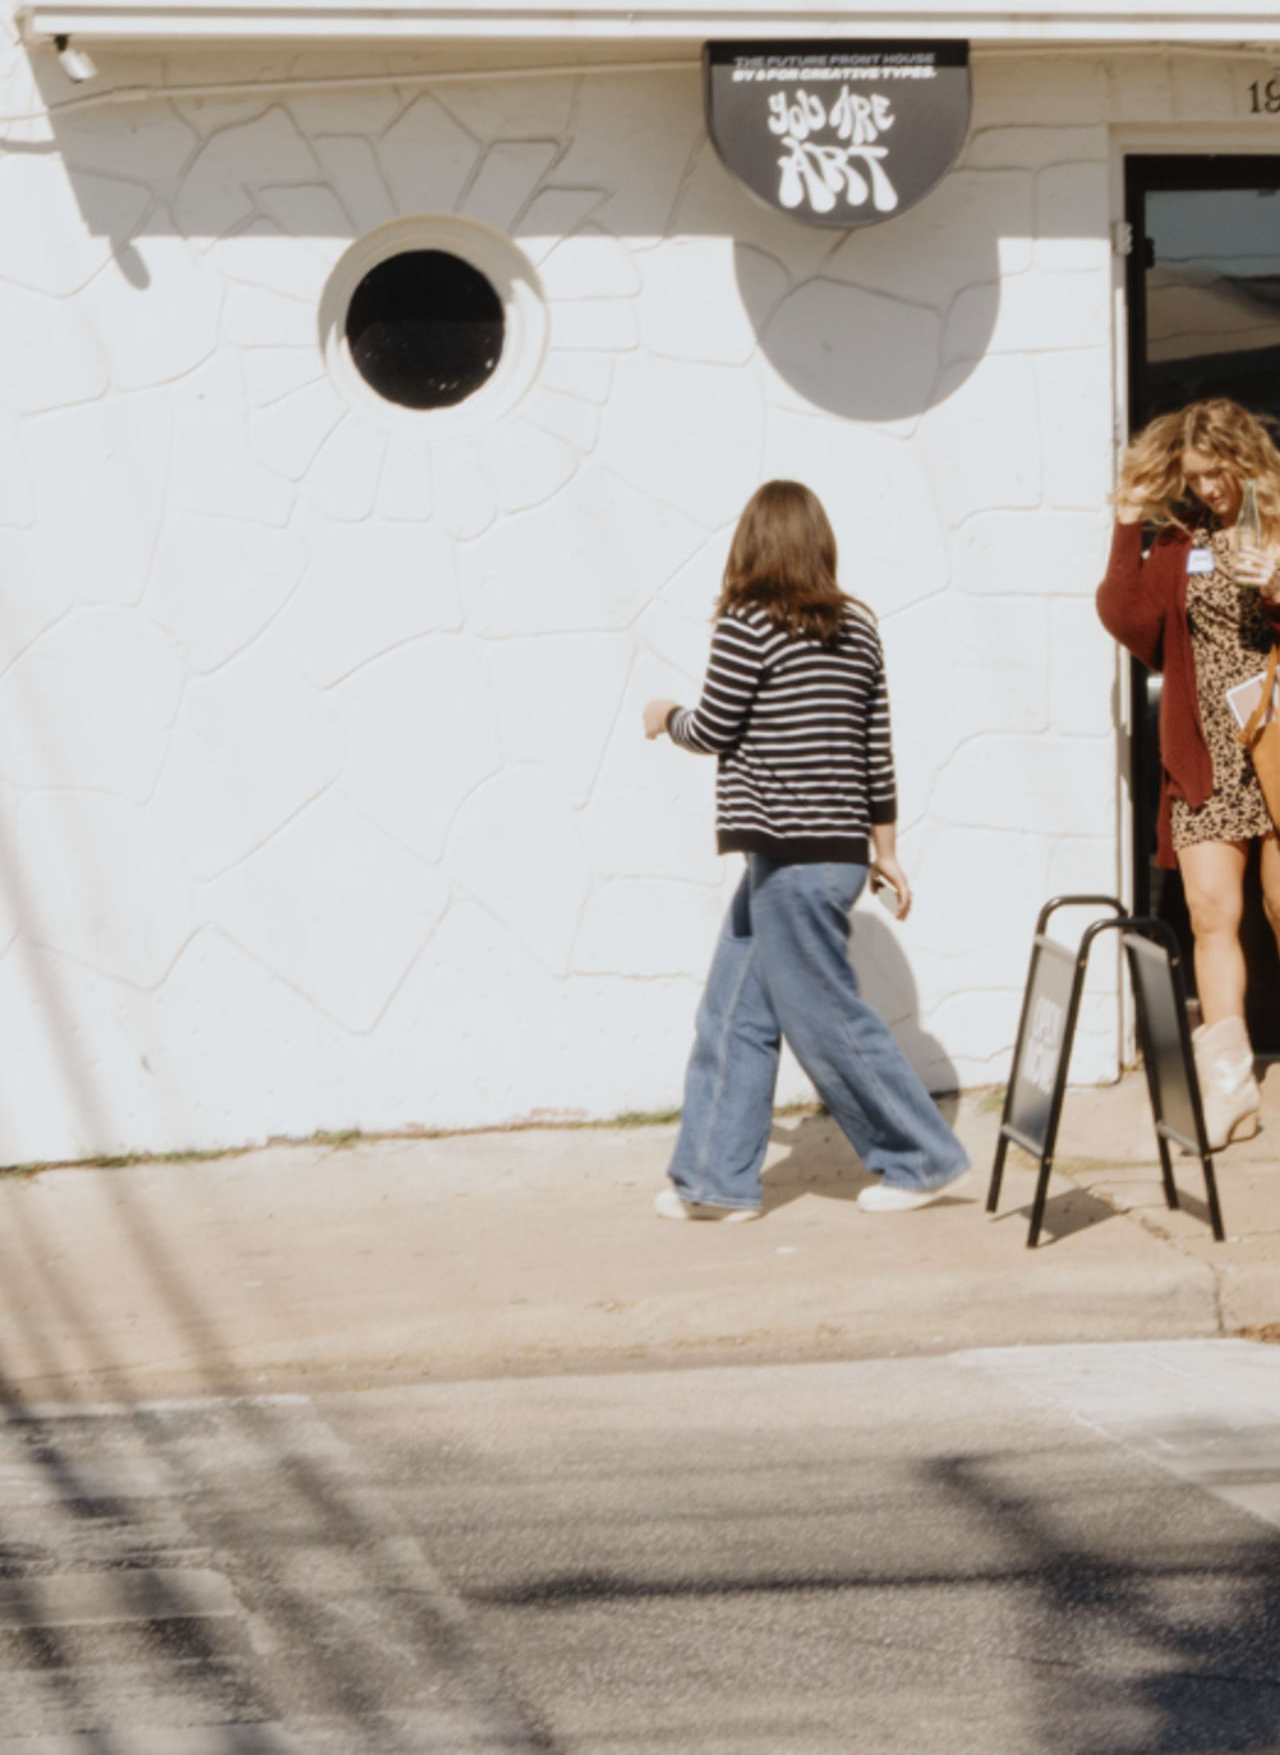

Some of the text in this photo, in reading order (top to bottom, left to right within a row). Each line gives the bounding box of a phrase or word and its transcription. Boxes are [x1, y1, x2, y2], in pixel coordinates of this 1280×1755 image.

[768, 84, 895, 145] YOU ARE
[777, 136, 898, 213] ART
